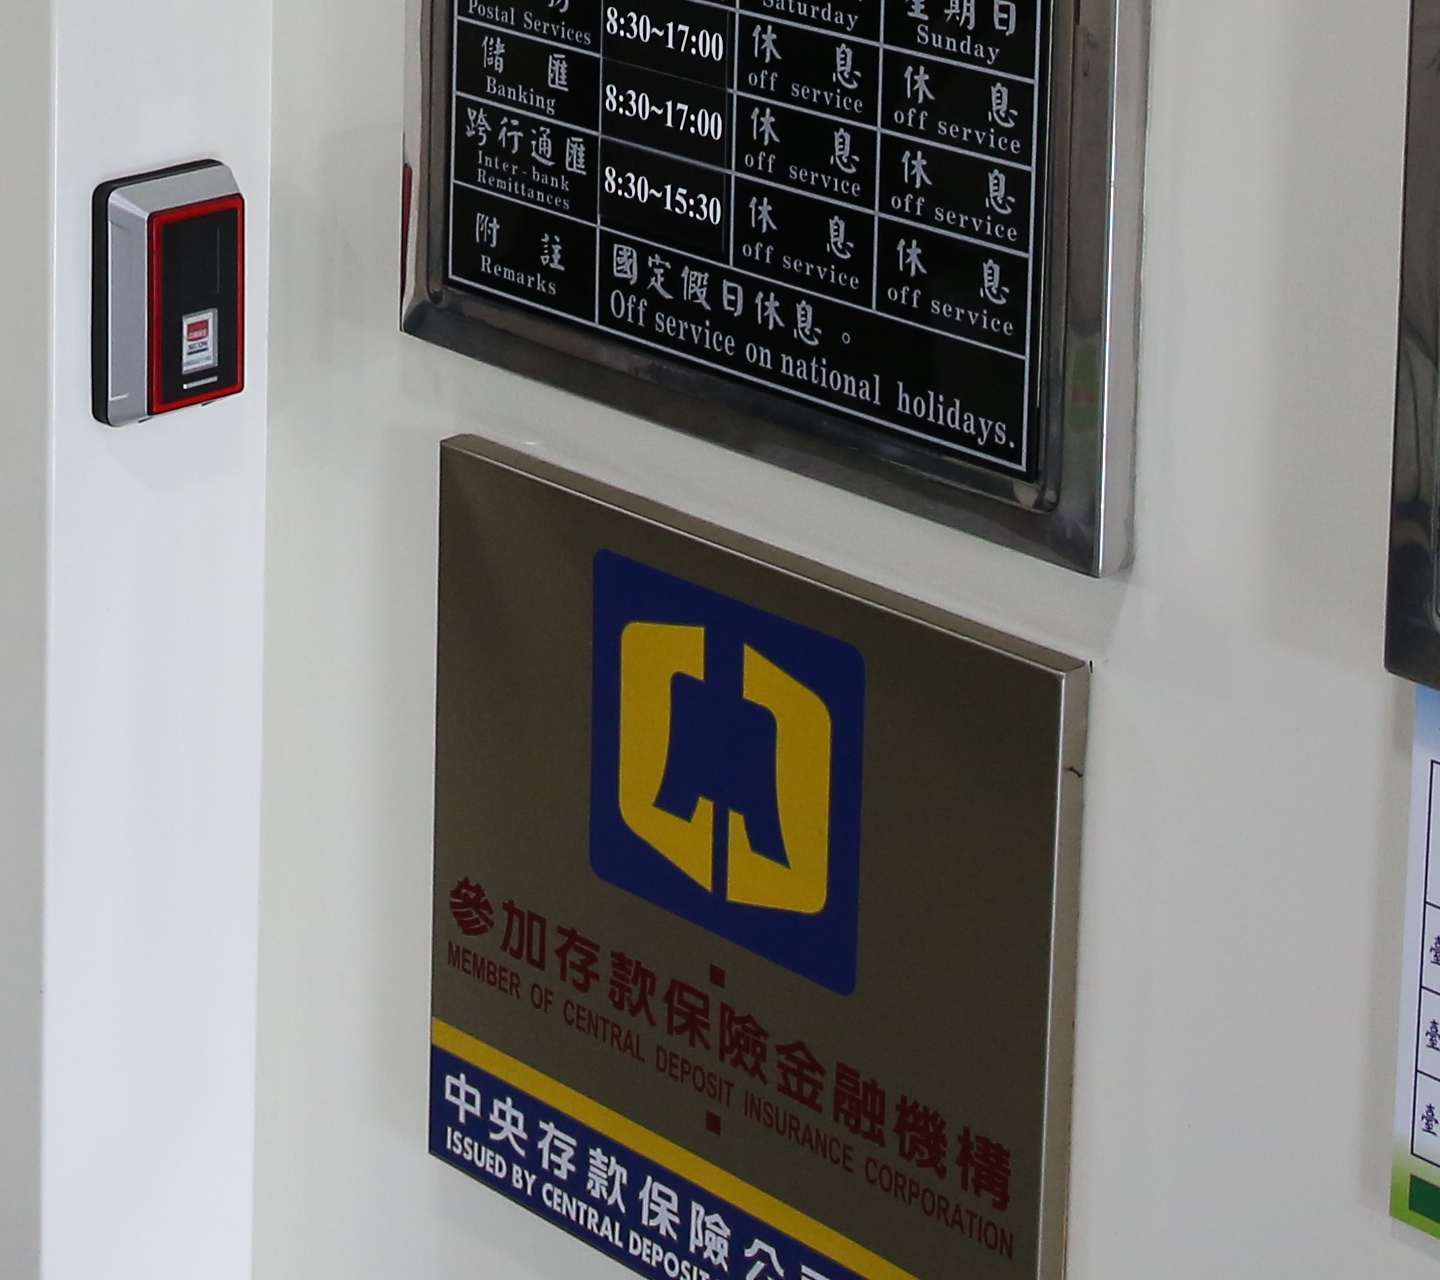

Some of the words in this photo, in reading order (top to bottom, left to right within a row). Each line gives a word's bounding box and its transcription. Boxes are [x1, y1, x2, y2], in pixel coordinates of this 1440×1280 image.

[523, 11, 591, 45] Services
[605, 7, 724, 61] 8:30~17:00
[915, 22, 1001, 65] Sunday
[481, 36, 569, 92] 儲匯
[752, 23, 861, 91] 休息
[485, 76, 556, 115] Banking
[605, 85, 723, 141] 8:30~17:00
[747, 63, 779, 91] off
[790, 79, 864, 114] service
[903, 64, 1020, 128] 休息
[465, 108, 587, 176] 跨行通匯
[751, 106, 861, 175] 休息
[893, 103, 928, 131] off
[936, 116, 1022, 155] service
[476, 168, 570, 210] Remittances
[604, 167, 721, 225] 8:30~15:30
[744, 146, 776, 172] off
[788, 163, 862, 199] service
[900, 150, 1017, 216] 休息
[475, 211, 566, 272] 附註
[748, 196, 854, 260] 休息
[890, 187, 925, 215] off
[933, 204, 1019, 242] service
[480, 254, 558, 296] Remarks
[742, 241, 773, 267] off
[782, 255, 860, 291] service
[896, 238, 1011, 306] 休息
[887, 285, 921, 309] off
[930, 298, 1014, 336] service
[610, 290, 647, 328] Off
[654, 307, 736, 355] service
[746, 339, 773, 368] on
[780, 350, 882, 406] national
[896, 380, 1015, 448] holidays.
[448, 876, 1012, 1213] 參加存款保險金融機構
[447, 940, 521, 1000] MEMBER
[530, 982, 554, 1013] OF
[562, 998, 646, 1064] CENTRAL
[655, 1044, 734, 1107] DEPOSIT
[743, 1090, 854, 1174] INSURANCE
[864, 1156, 1014, 1261] CORPORATION
[444, 1073, 831, 1280] 中央存款保險公
[446, 1126, 507, 1180] ISSUED
[511, 1163, 537, 1196] BY
[541, 1182, 624, 1248] CENTRAL
